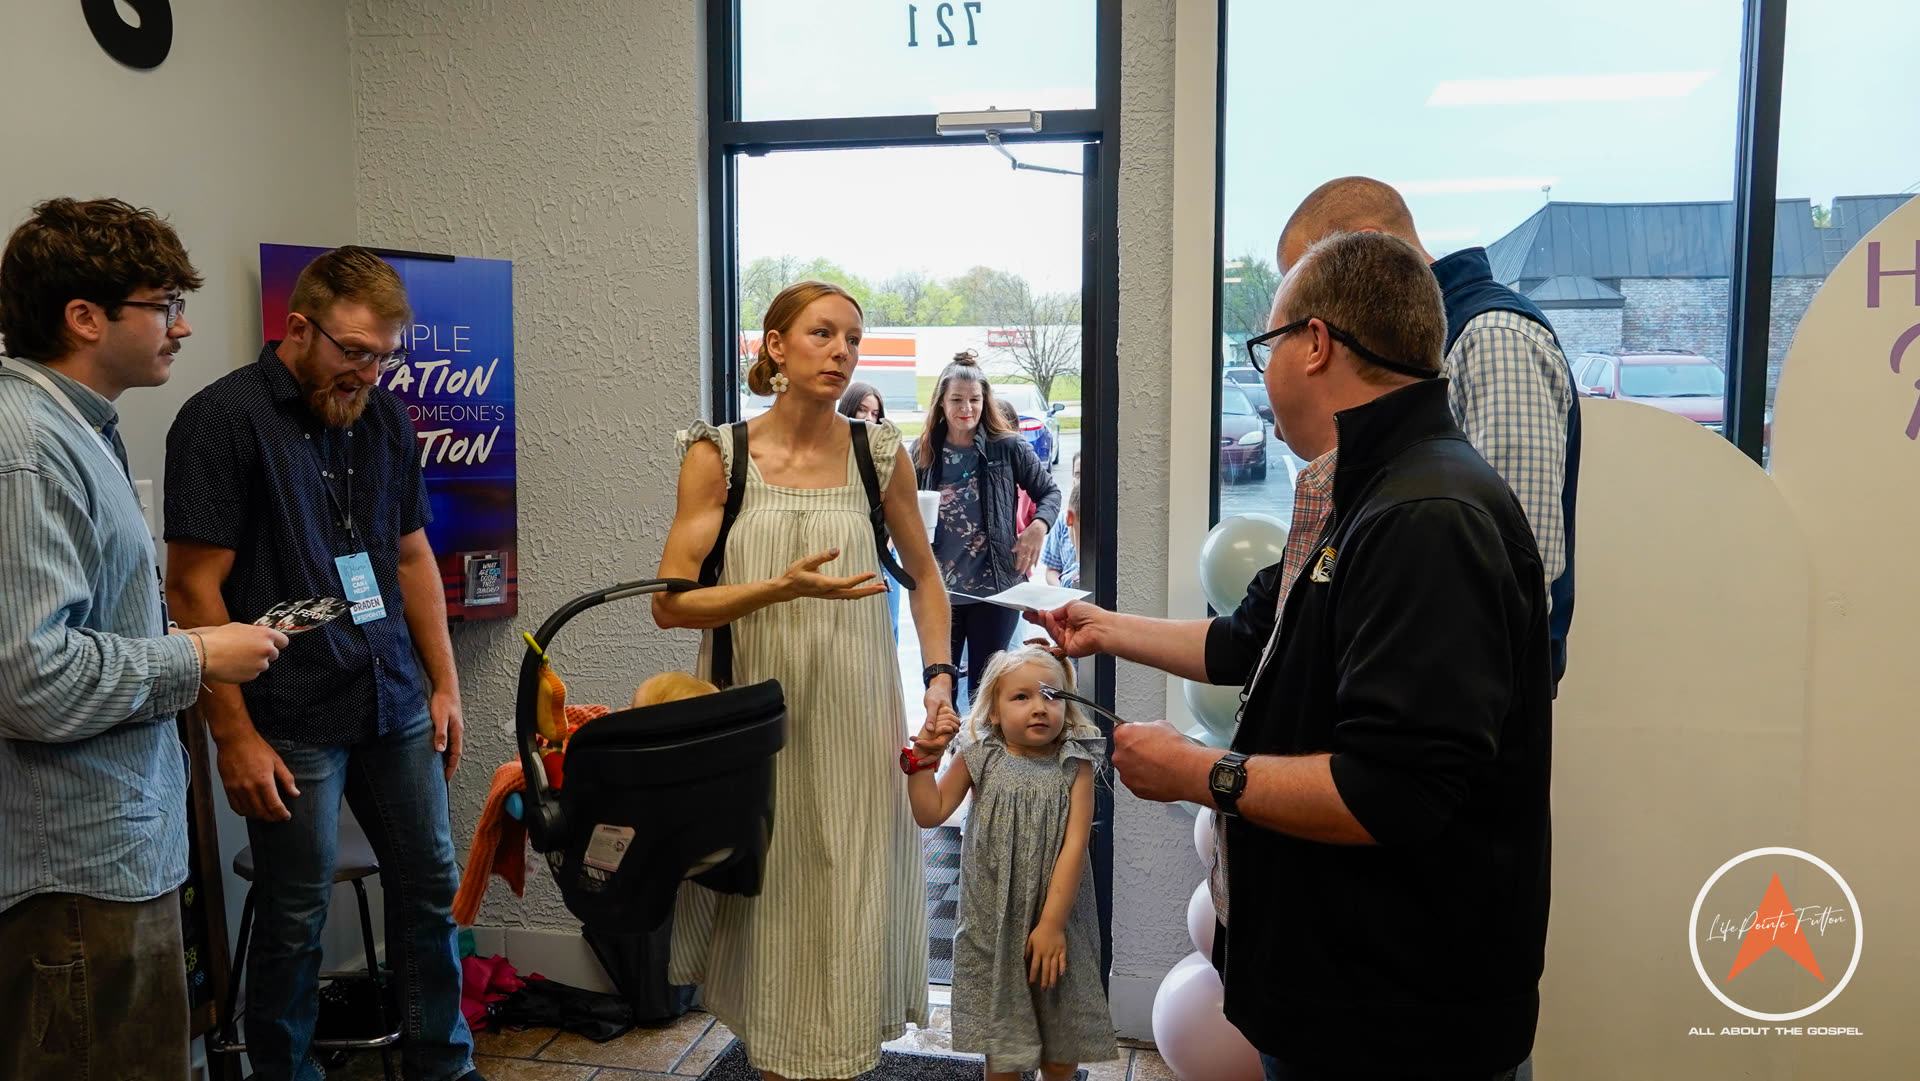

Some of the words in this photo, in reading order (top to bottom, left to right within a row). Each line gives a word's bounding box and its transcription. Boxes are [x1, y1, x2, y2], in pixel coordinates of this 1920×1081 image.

[377, 358, 499, 398] ATION
[406, 405, 505, 421] OMEONE'S
[417, 425, 500, 468] TION
[476, 586, 500, 594] SUNDAY?
[353, 598, 381, 612] BRADEN
